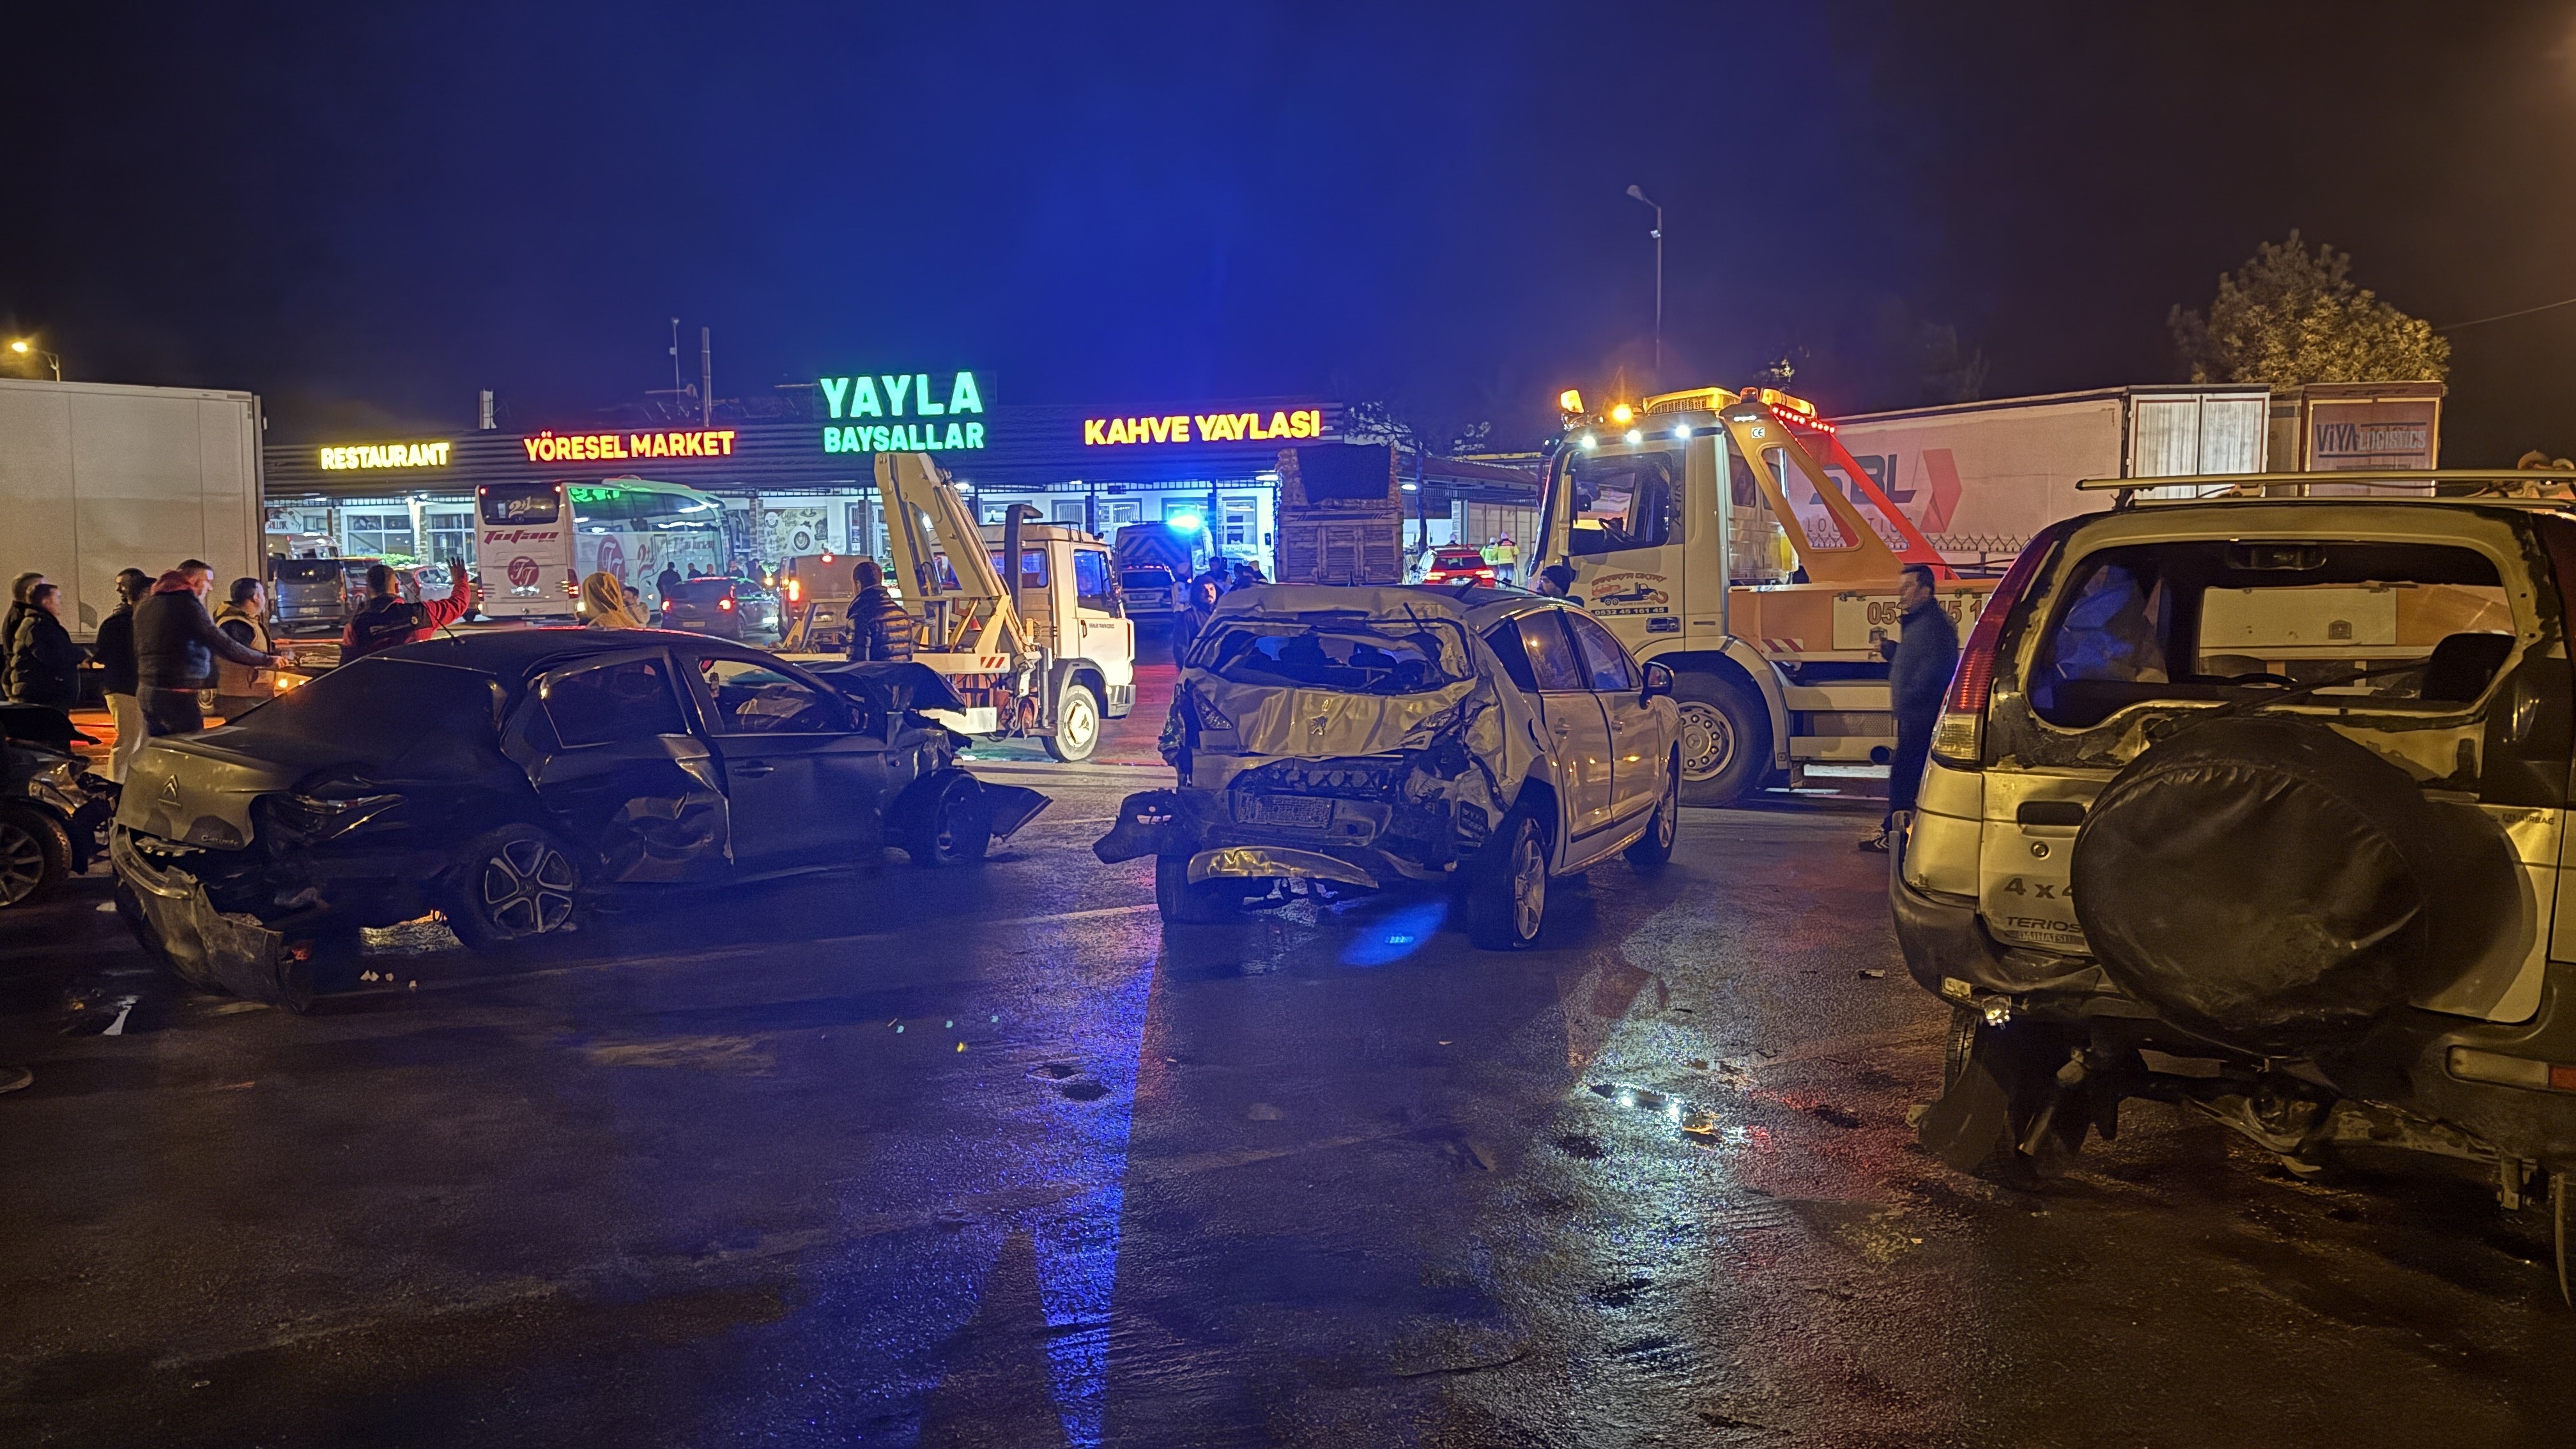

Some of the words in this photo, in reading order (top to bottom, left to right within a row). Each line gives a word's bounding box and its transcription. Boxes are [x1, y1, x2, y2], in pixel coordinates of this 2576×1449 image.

[820, 371, 983, 418] YAYLA
[824, 422, 984, 452] BAYSALLAR
[1085, 415, 1190, 445] KAHVE
[1194, 410, 1320, 441] YAYLASI
[321, 442, 450, 470] RESTAURANT
[524, 431, 628, 461] YÖRESEL
[631, 431, 735, 457] MARKET
[2007, 917, 2082, 933] TERIOS
